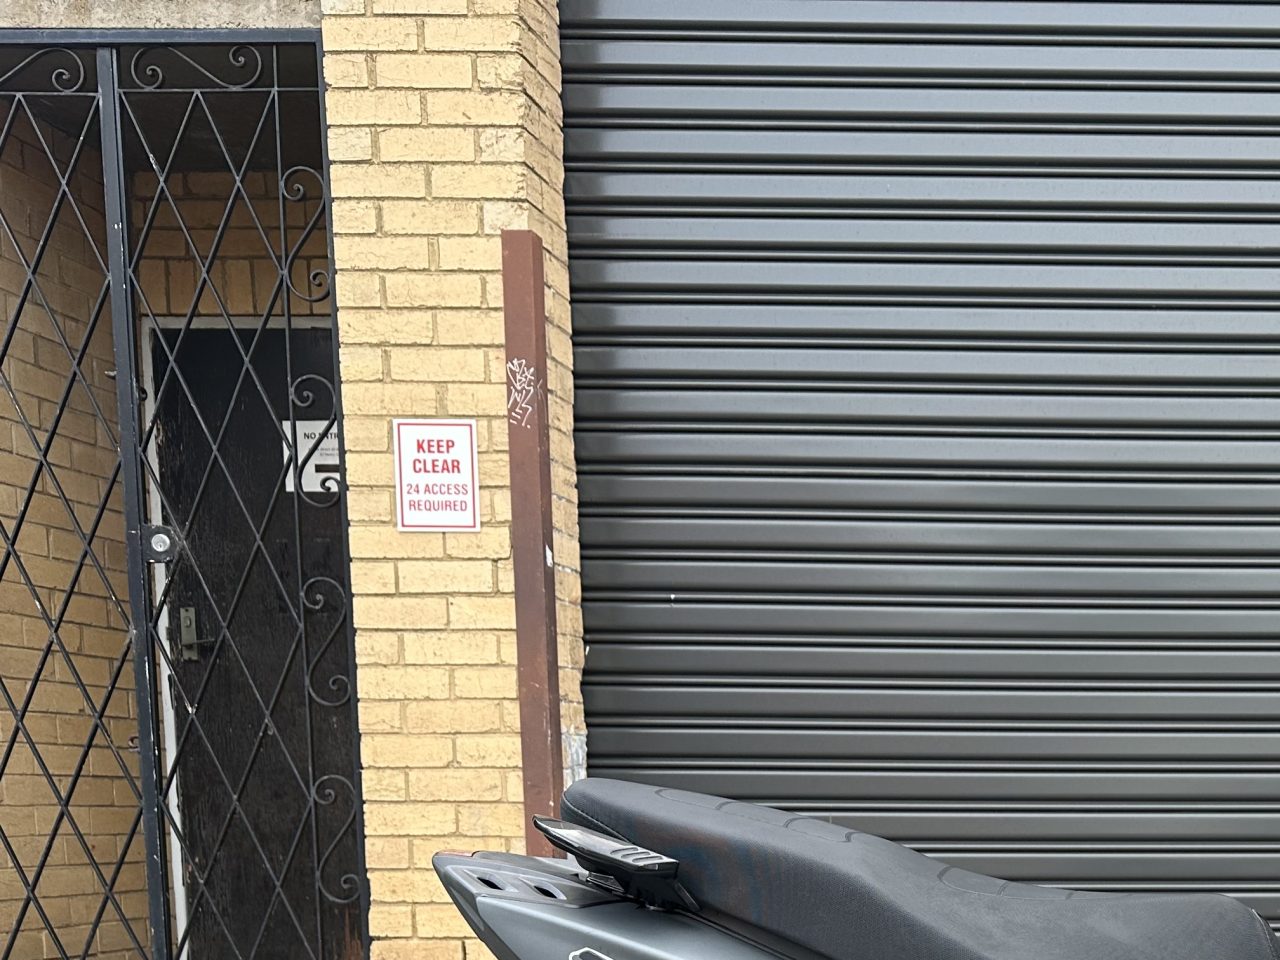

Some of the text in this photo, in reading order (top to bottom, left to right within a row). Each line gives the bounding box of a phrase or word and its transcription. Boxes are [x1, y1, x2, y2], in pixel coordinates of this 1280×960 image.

[303, 431, 317, 441] NO
[416, 439, 455, 454] KEEP
[412, 458, 461, 474] CLEAR
[406, 483, 469, 496] 24 ACCESS
[408, 499, 468, 512] REQUIRED
